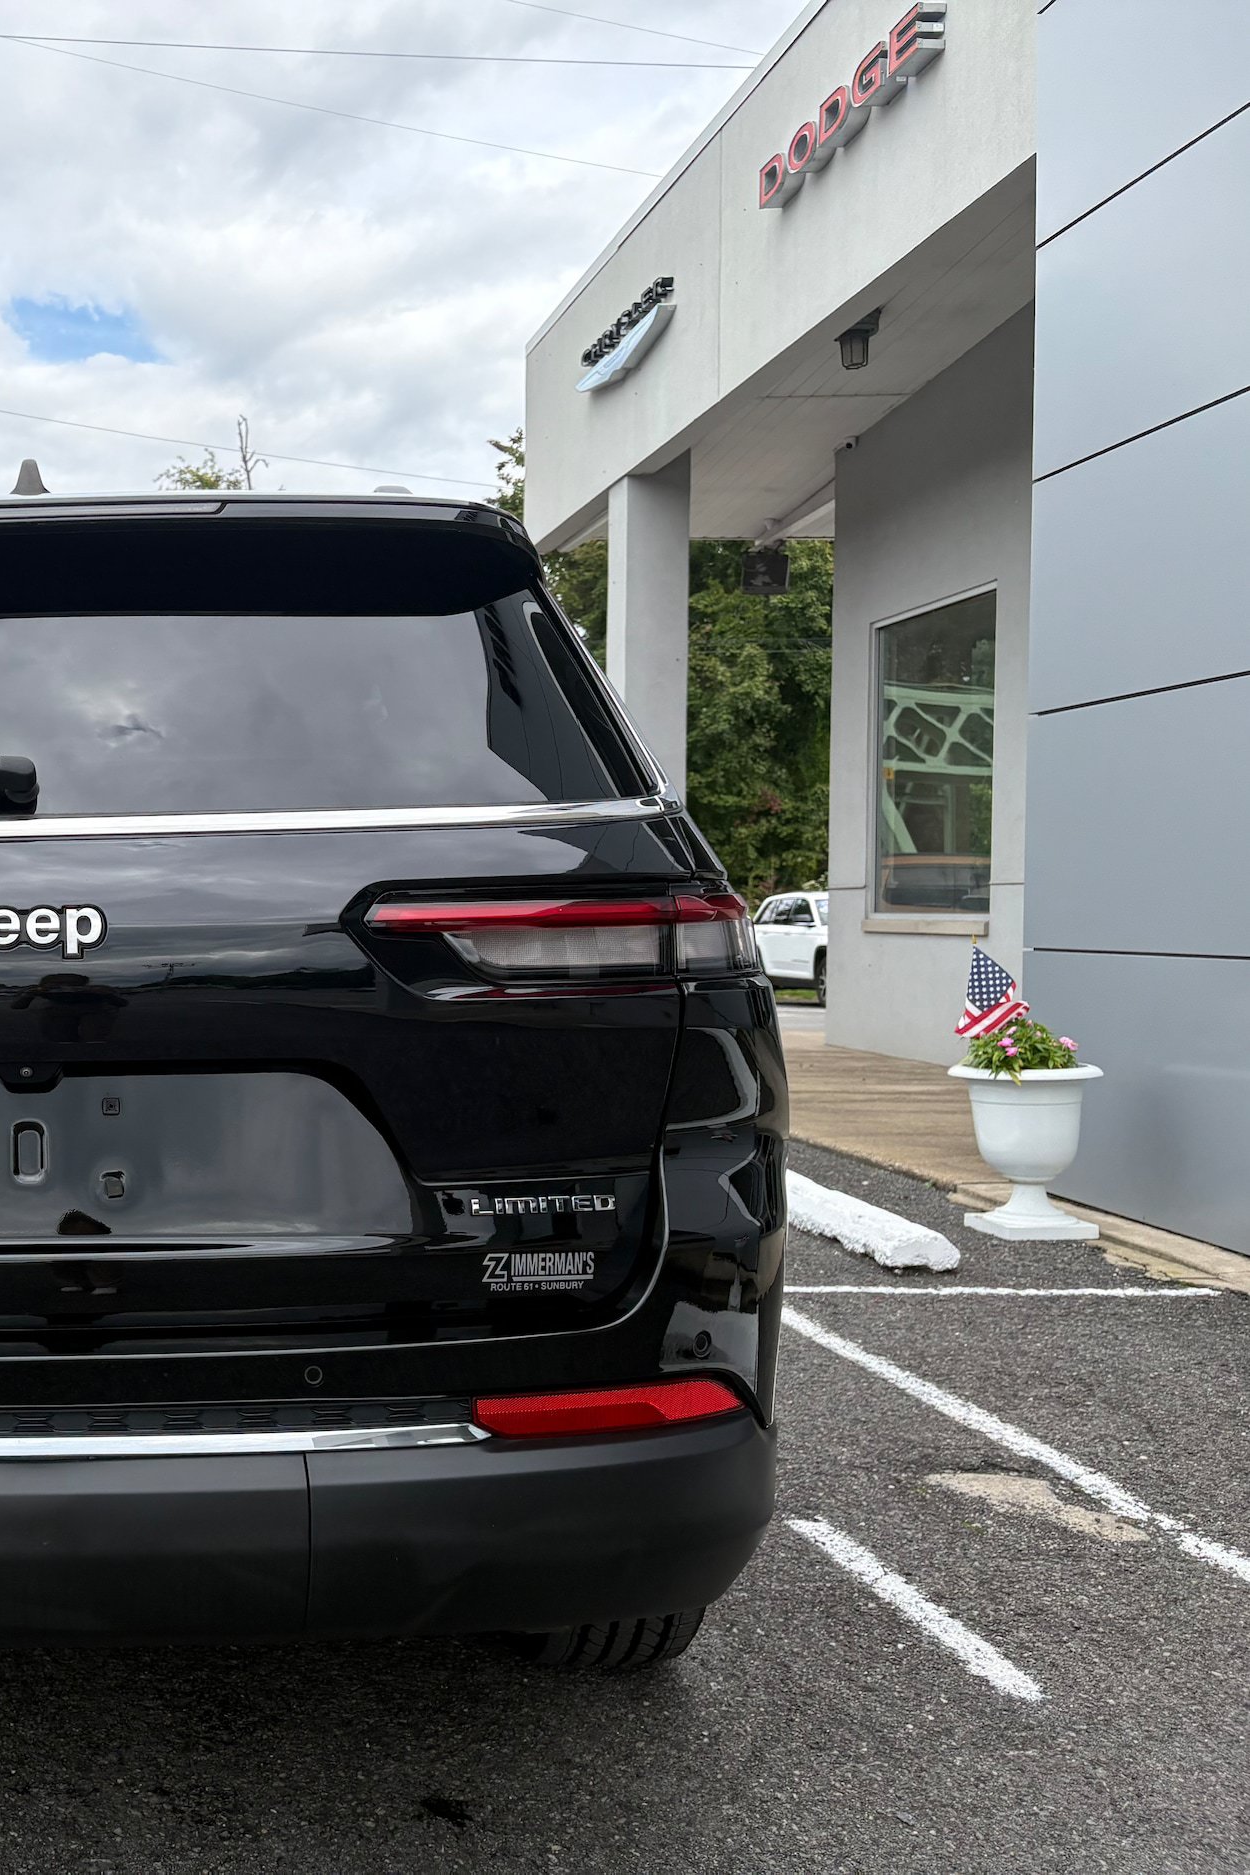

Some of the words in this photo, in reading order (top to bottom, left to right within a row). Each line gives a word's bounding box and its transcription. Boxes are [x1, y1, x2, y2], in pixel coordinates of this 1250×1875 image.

[759, 2, 940, 209] DODGE
[470, 1194, 616, 1216] LIMITED
[482, 1252, 595, 1282] ZIMMERMAN'S
[490, 1282, 522, 1291] ROUTE
[523, 1282, 534, 1291] 61
[540, 1281, 584, 1290] SUNBURY
